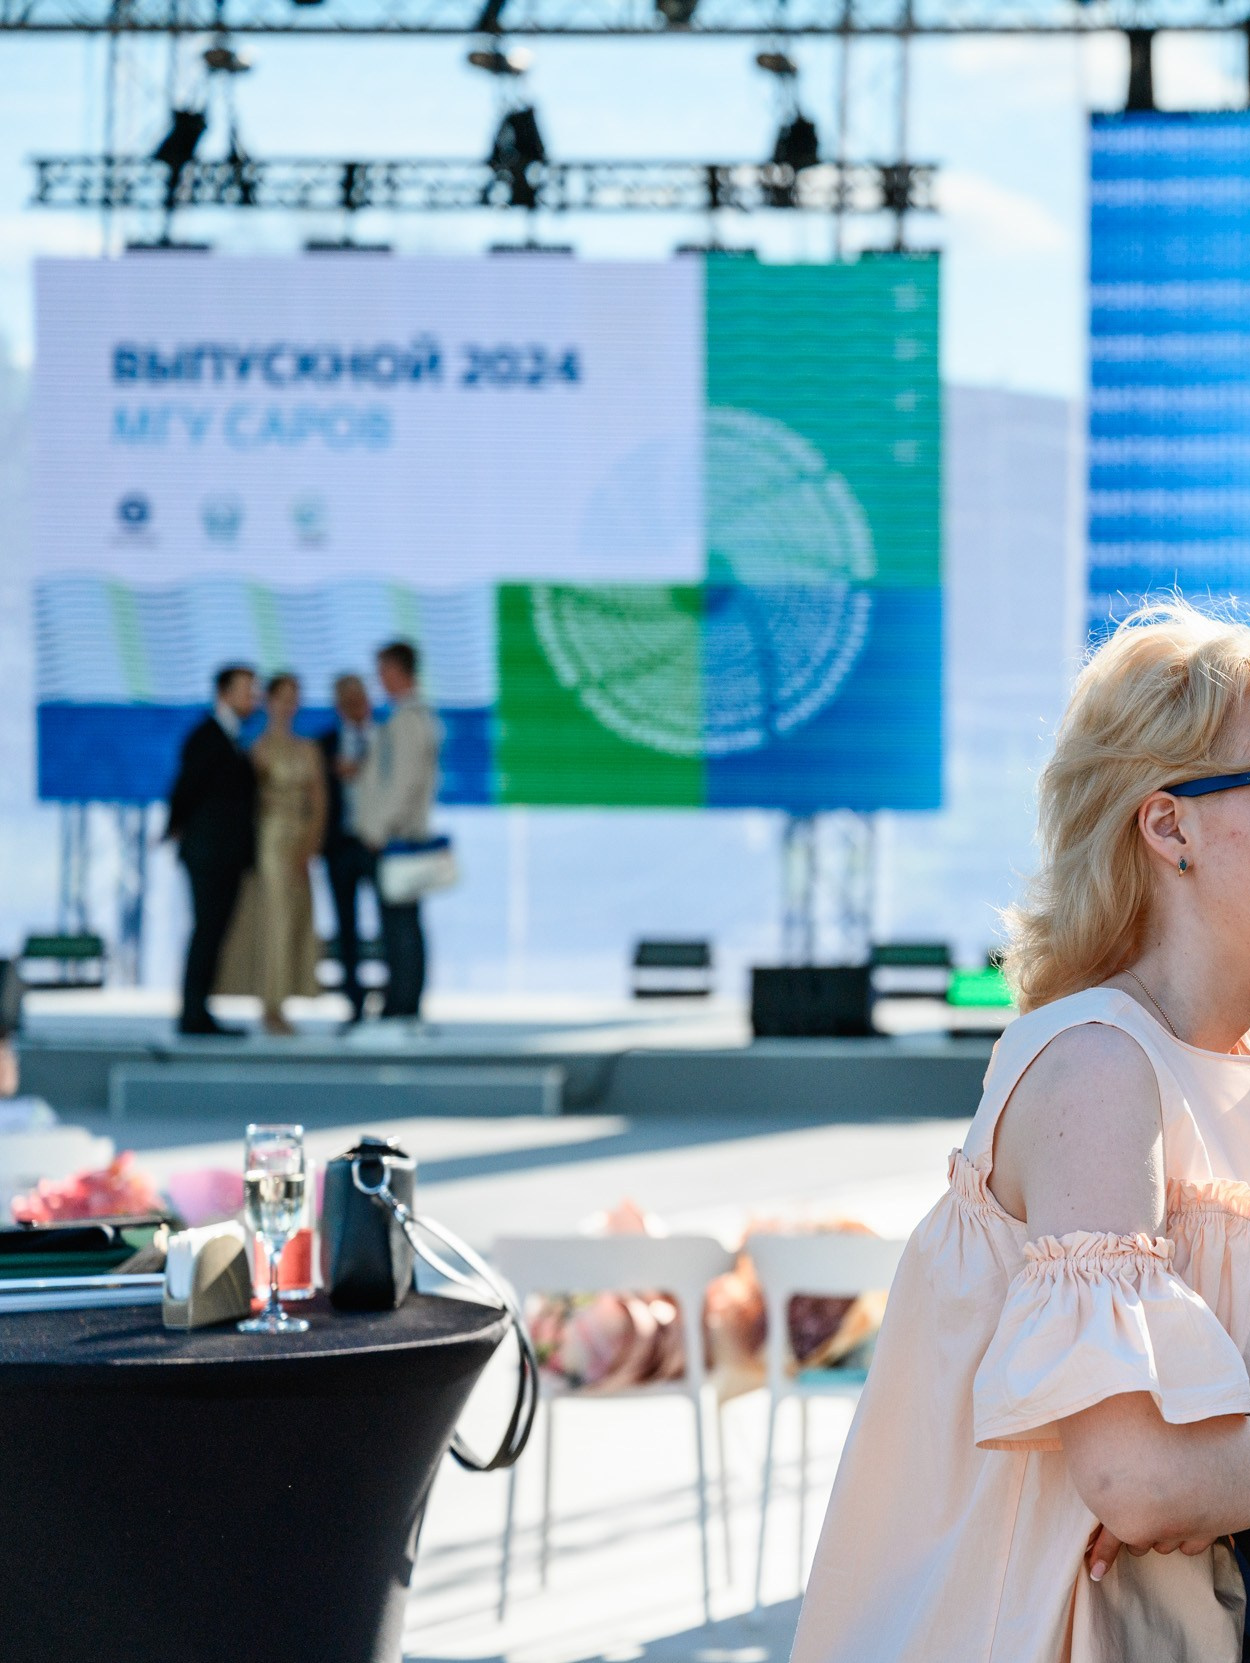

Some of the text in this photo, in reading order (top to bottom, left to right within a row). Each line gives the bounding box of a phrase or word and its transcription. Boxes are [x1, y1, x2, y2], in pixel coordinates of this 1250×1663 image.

[112, 335, 582, 386] ВЫПУСКНОЙ 2024
[112, 406, 393, 450] МГУ САРОВ
